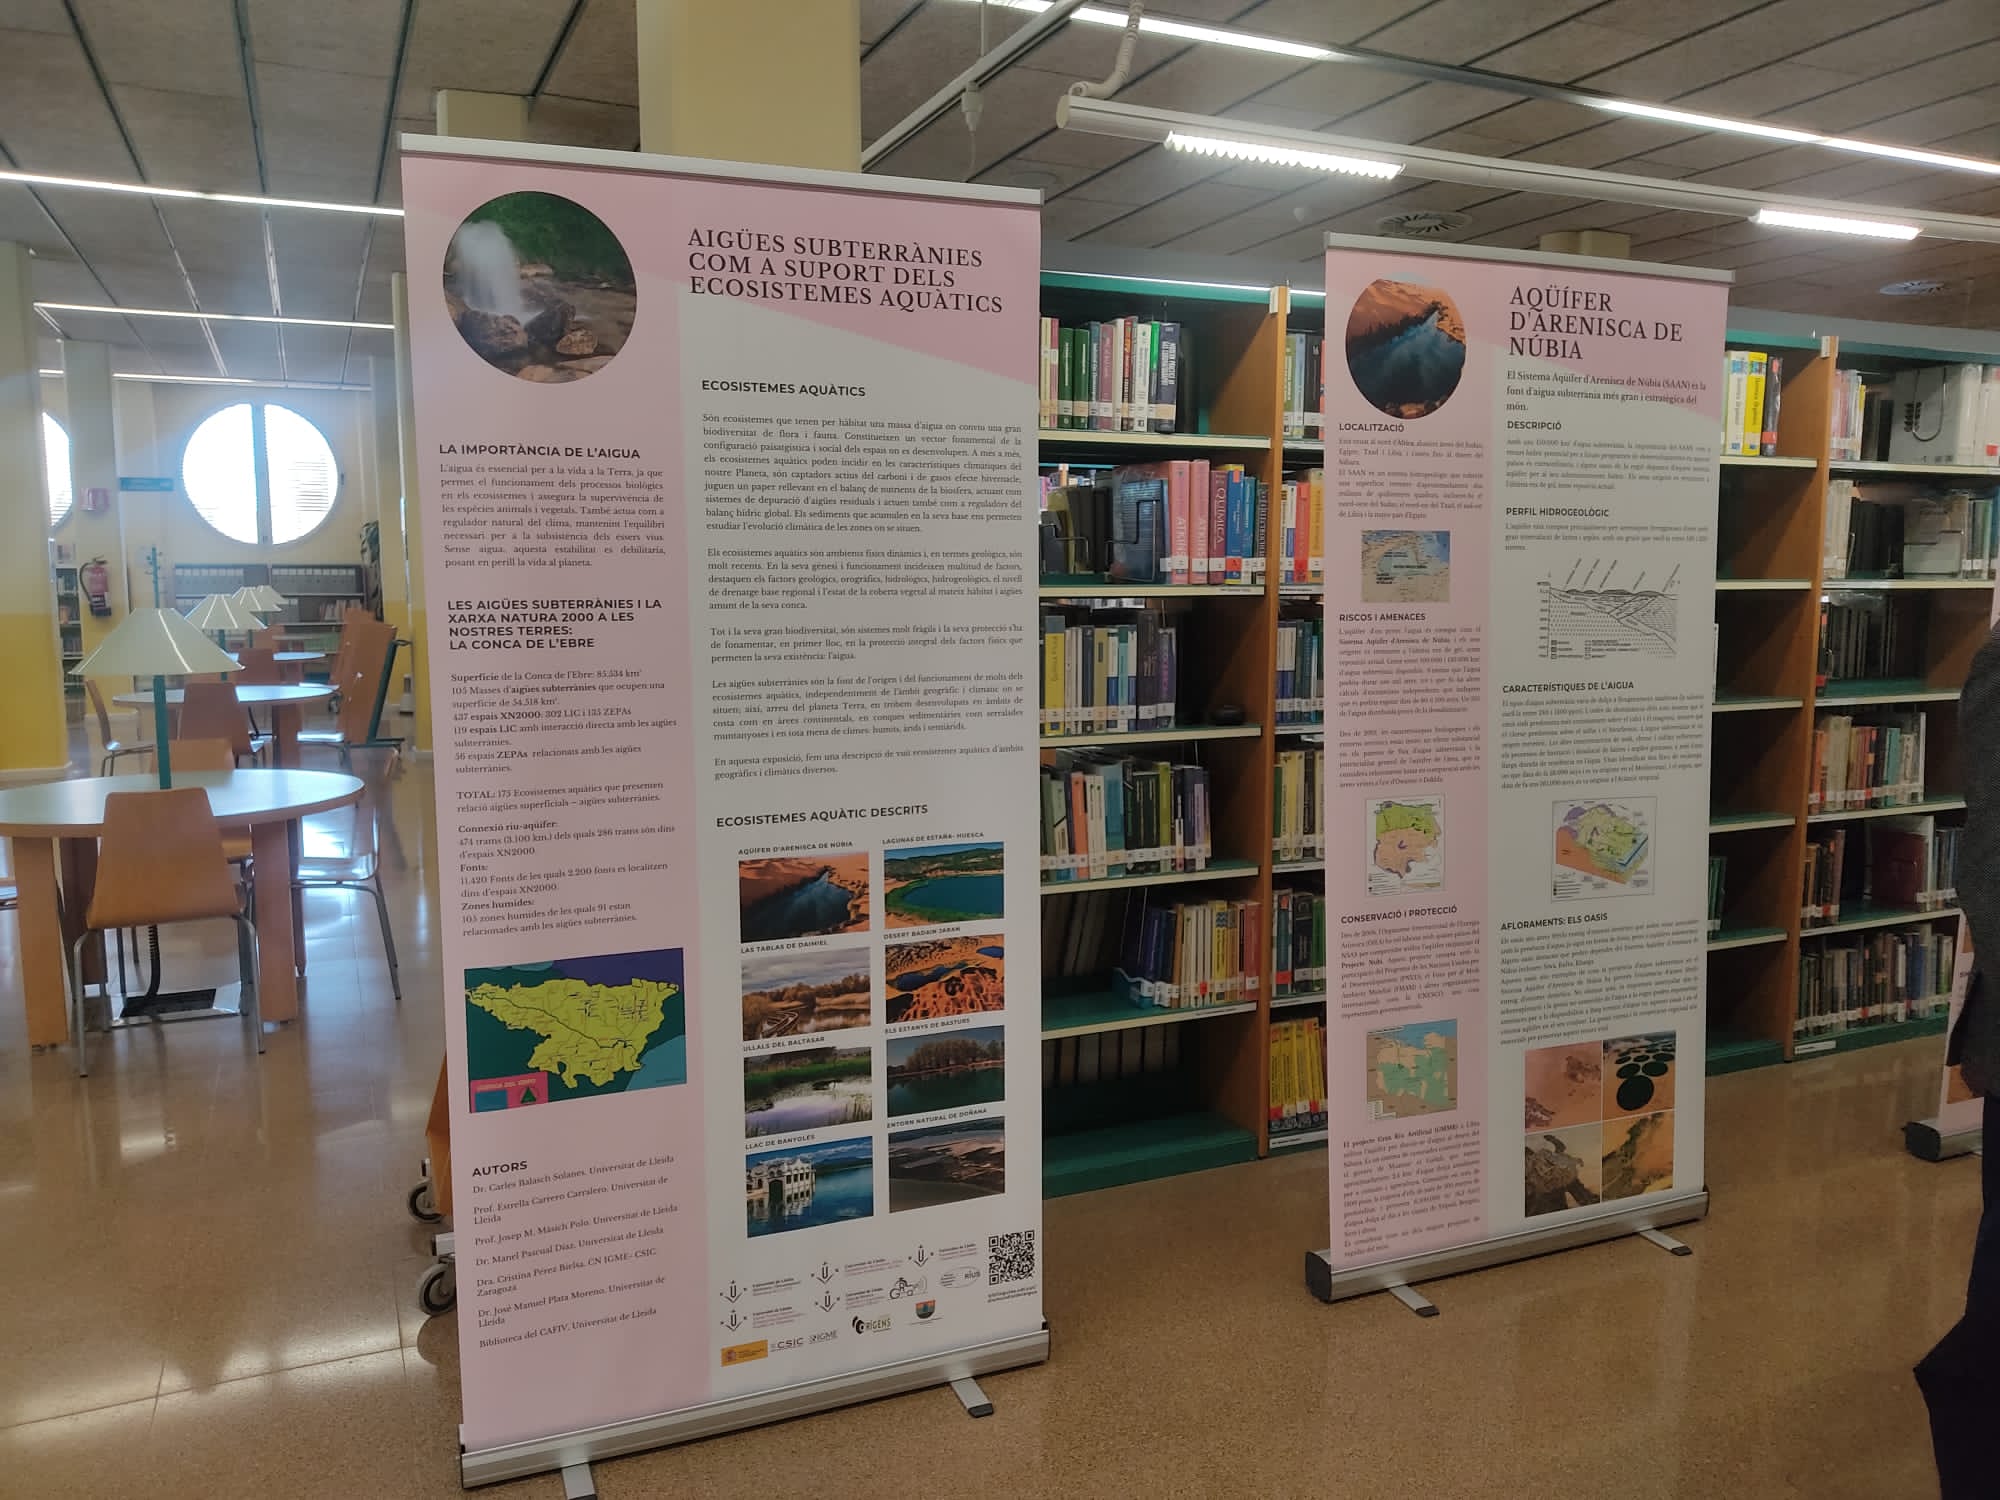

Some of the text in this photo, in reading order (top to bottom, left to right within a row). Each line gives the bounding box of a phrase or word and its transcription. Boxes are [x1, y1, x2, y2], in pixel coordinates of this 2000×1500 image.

[688, 228, 982, 268] AIGÜES SUBTERRÀNIES
[689, 252, 954, 288] COM A SUPORT DELS
[690, 276, 1002, 313] ECOSISTEMES AQUÀTICS
[1509, 284, 1613, 312] AQÜÍFER
[1509, 311, 1682, 342] D'ARENISCA DE
[1509, 334, 1583, 360] NÚBIA
[702, 380, 866, 397] ECOSISTEMES AQUÀTICS
[1339, 422, 1405, 433] LOCALITZACIÓ
[1507, 420, 1562, 431] DESCRIPCIÓ
[439, 444, 641, 459] LA IMPORTÀNCIA DE L'AIGUA
[1506, 507, 1537, 516] PERFIL
[448, 597, 662, 610] LES AIGÜES SUBTERRÀNIES I LA
[448, 612, 634, 624] XARXA NATURA 2000 A LES
[1339, 613, 1373, 622] RISCOS
[1379, 613, 1426, 621] AMENACES
[449, 626, 573, 637] NOSTRES TERRES:
[449, 638, 595, 650] LA CONCA DE L'EBRE
[1502, 682, 1586, 693] CARACTERÍSTIQUES
[1587, 682, 1599, 691] DE
[716, 804, 928, 828] ECOSISTEMES AQUÀTIC DESCRITS
[1340, 904, 1458, 924] CONSERVACIÓ I PROTECCIÓ
[1567, 915, 1582, 924] ELS
[1583, 912, 1608, 923] OASIS
[472, 1160, 528, 1177] AUTORS
